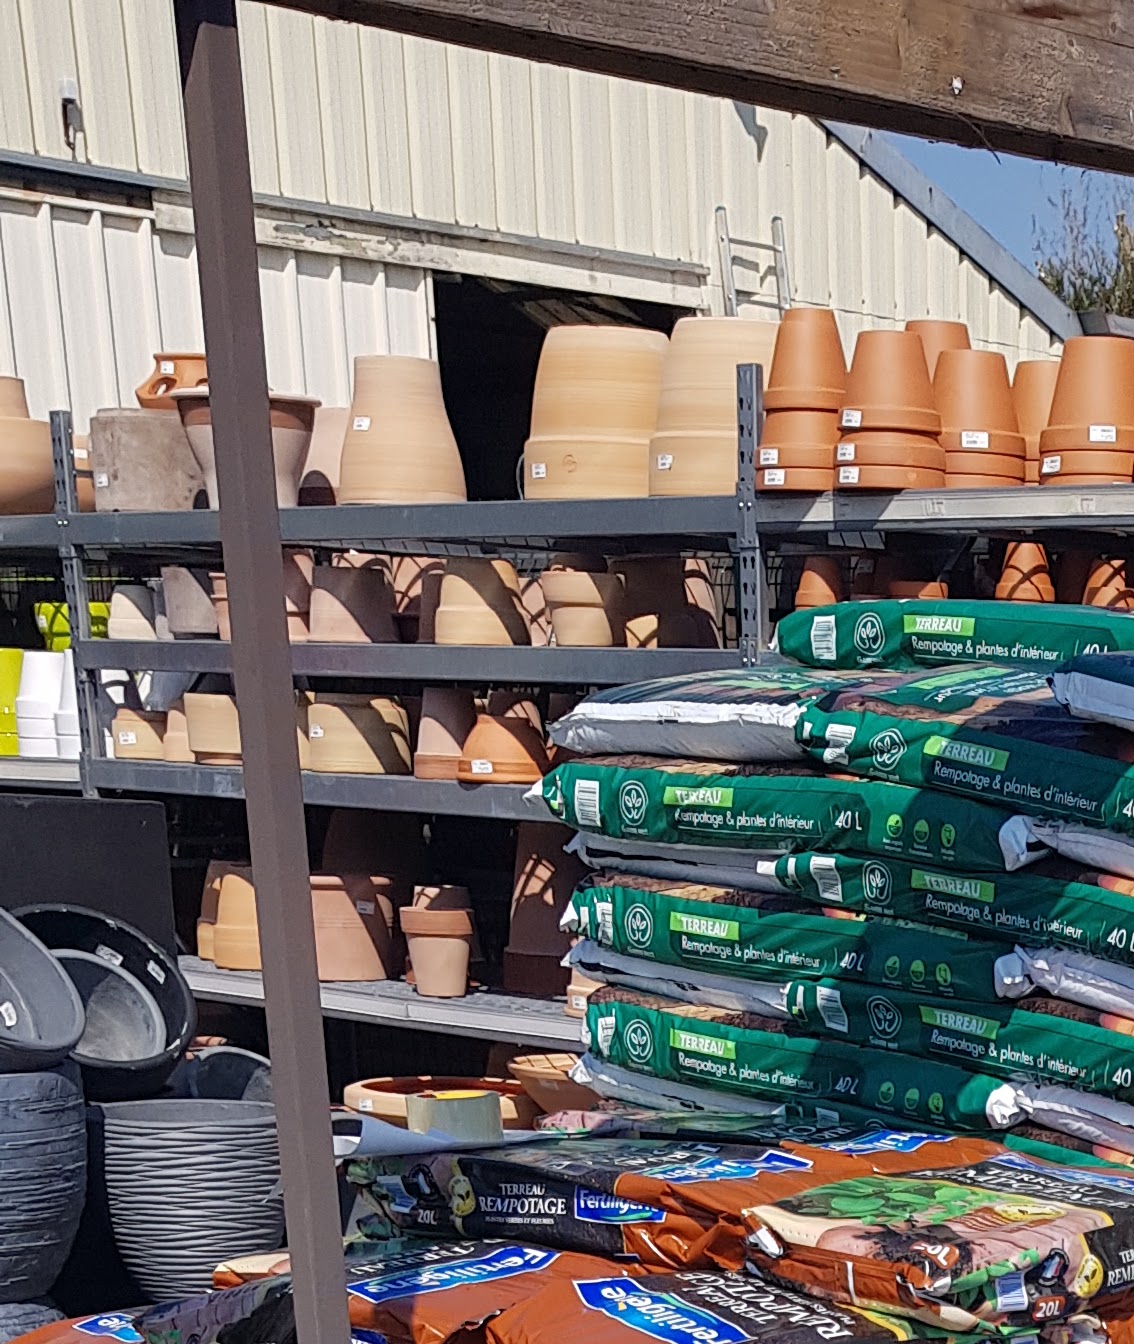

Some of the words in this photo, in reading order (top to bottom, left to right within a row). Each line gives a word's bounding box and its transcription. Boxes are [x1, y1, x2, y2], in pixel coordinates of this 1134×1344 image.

[915, 617, 962, 632] TERREAU
[911, 637, 963, 655] Rempotage
[975, 642, 1008, 660] plantes
[1011, 642, 1059, 661] d'intérieur
[938, 740, 995, 767] TERREAU
[934, 760, 990, 789] Rempotage
[1003, 777, 1042, 800] plantes
[1044, 786, 1098, 812] d'intérieur
[675, 809, 724, 829] Rempotage
[736, 813, 767, 830] plantes
[769, 813, 814, 830] d'intérieur
[835, 811, 851, 828] 40
[924, 874, 981, 898] TERREAU
[680, 915, 728, 937] TERREAU
[926, 894, 981, 922] Rempotage
[996, 908, 1031, 929] plantes
[1033, 916, 1083, 940] d'intérieur
[1107, 928, 1128, 948] 40
[682, 935, 732, 959] Rempotage
[743, 946, 775, 964] plantes
[777, 948, 820, 968] d'intérieur
[840, 951, 857, 969] 40
[934, 1008, 988, 1034] TERREAU
[678, 1032, 725, 1056] TERREAU
[930, 1029, 985, 1058] Rempotage
[988, 1043, 998, 1058] &
[1000, 1044, 1034, 1069] plantes
[1036, 1049, 1087, 1079] d'intérieur
[1112, 1068, 1132, 1087] 40
[499, 1184, 546, 1196] TERREAU
[478, 1196, 567, 1216] REMPOTAGE
[417, 1209, 437, 1226] 20L
[1035, 1301, 1060, 1318] 20L
